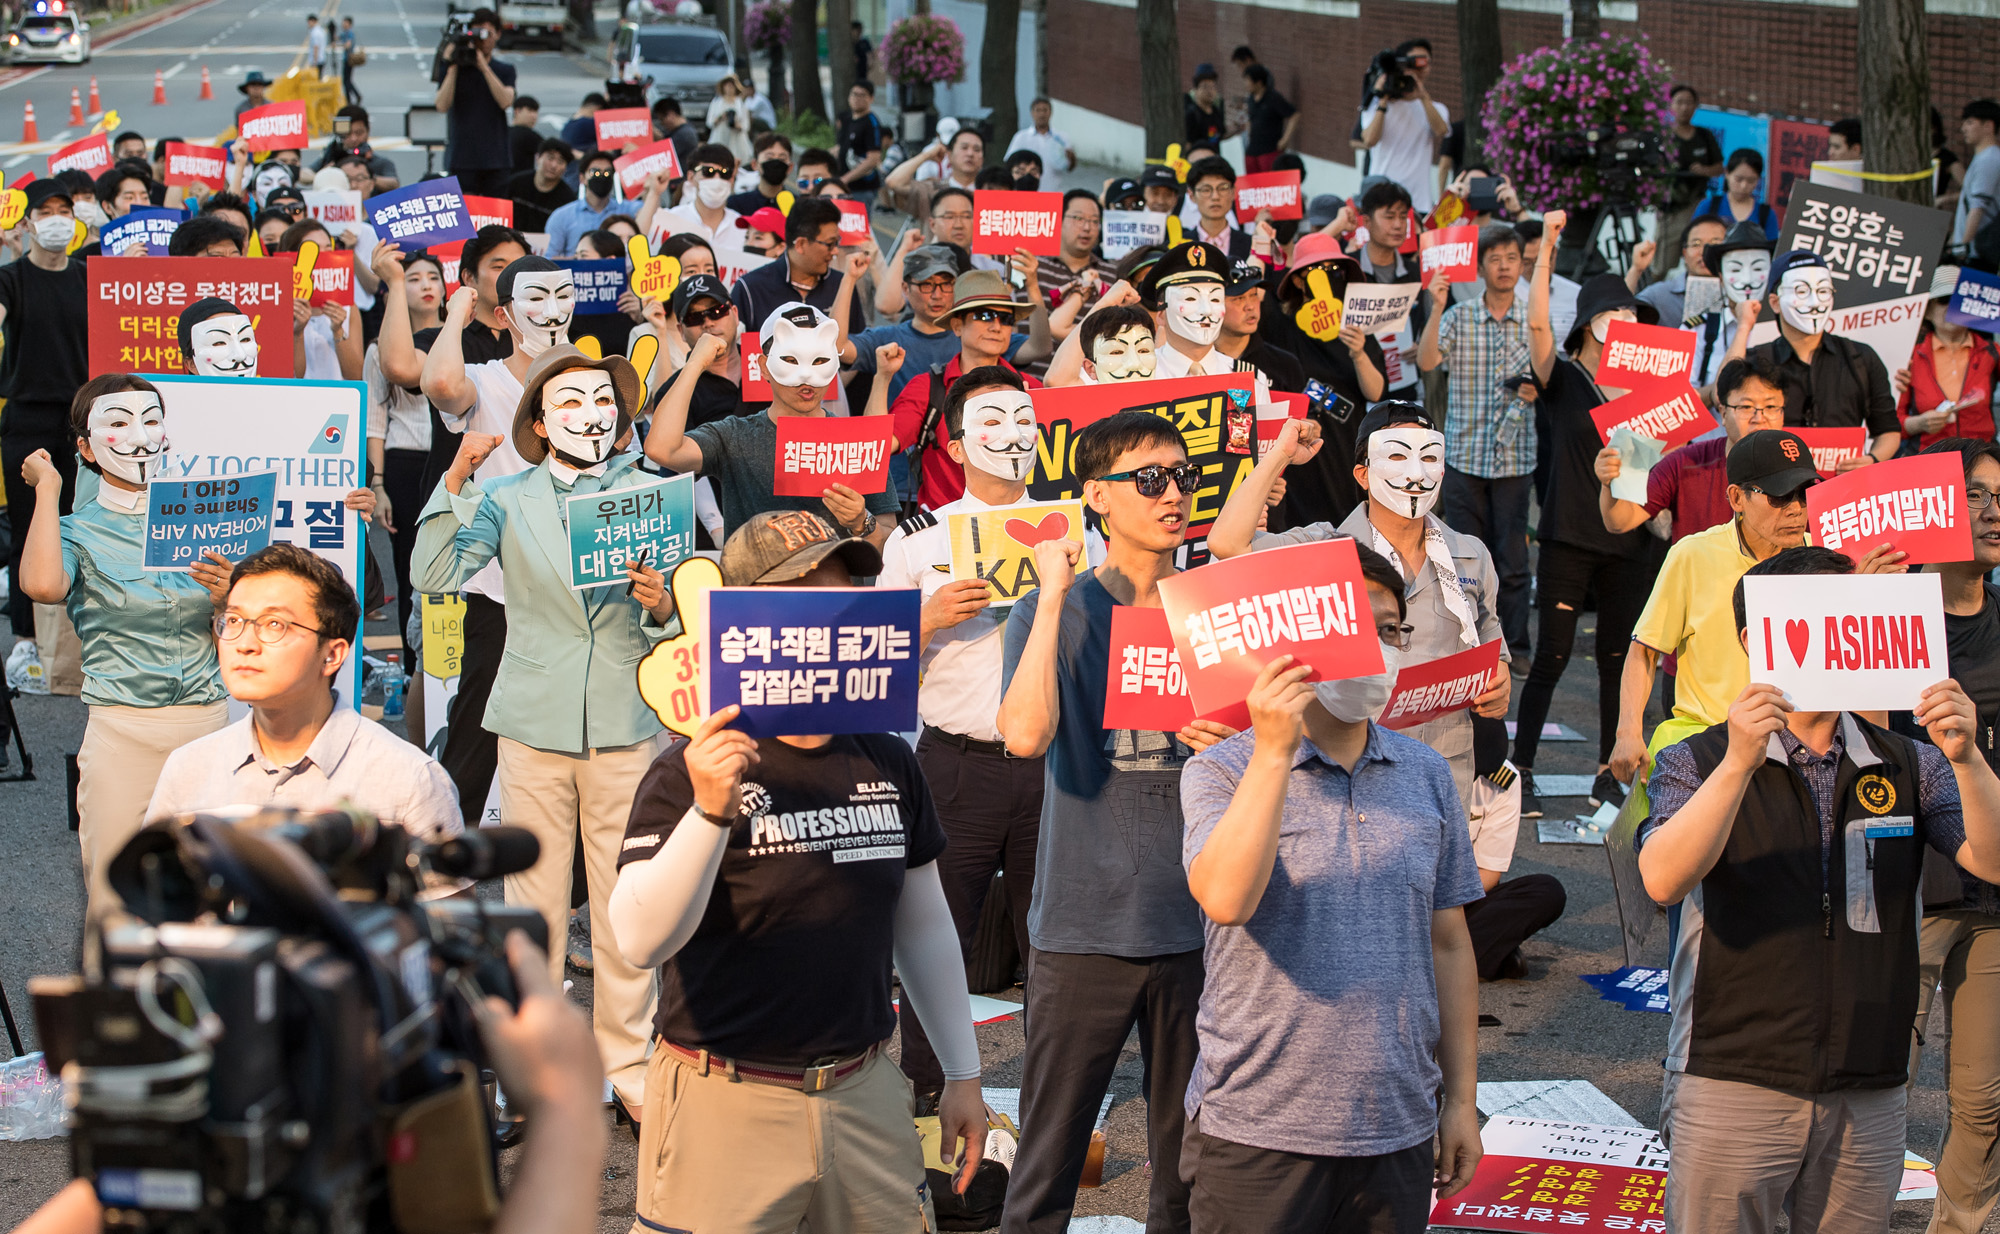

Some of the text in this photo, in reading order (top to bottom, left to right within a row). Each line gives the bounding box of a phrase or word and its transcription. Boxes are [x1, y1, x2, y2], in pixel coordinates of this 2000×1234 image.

[374, 198, 427, 226] 승객·직원
[437, 211, 459, 229] OUT
[979, 209, 1058, 237] 침묵하지말자!
[1797, 199, 1904, 247] 조양호는
[311, 267, 350, 292] 지말자!
[645, 260, 661, 277] 39
[100, 280, 188, 306] 더이상은
[599, 286, 618, 302] OUT
[640, 273, 672, 294] OUT!
[1310, 300, 1329, 318] 39
[1311, 308, 1342, 334] OUT!
[1842, 301, 1923, 331] MERCY!
[1606, 340, 1690, 378] 침묵하지말자!
[784, 439, 886, 475] 침묵하지말자!
[195, 479, 240, 498] CHO
[160, 503, 187, 516] on
[597, 489, 664, 525] 우리가
[1819, 485, 1955, 550] 침묵하지말자!
[151, 514, 268, 540] KOREAN AIR
[594, 514, 672, 546] 지켜낸다!
[970, 516, 982, 554] I
[172, 539, 248, 562] Proud of
[579, 530, 691, 578] 대한항공!
[976, 556, 1041, 598] KA
[1457, 576, 1478, 586] REAN
[1184, 580, 1359, 670] 침묵하지말자!
[720, 624, 911, 664] 승객·직원 굶기는
[1763, 614, 1931, 671] I ASIANA
[739, 668, 840, 706] 갑질삼구
[845, 667, 893, 702] OUT
[1388, 667, 1493, 719] 침묵하지말자!
[750, 803, 904, 846] PROFESSIONAL
[871, 833, 906, 845] SECONDS
[835, 851, 863, 862] SPEED
[1452, 1202, 1591, 1226] 못참겠다
[1614, 1198, 1665, 1214] 러운
